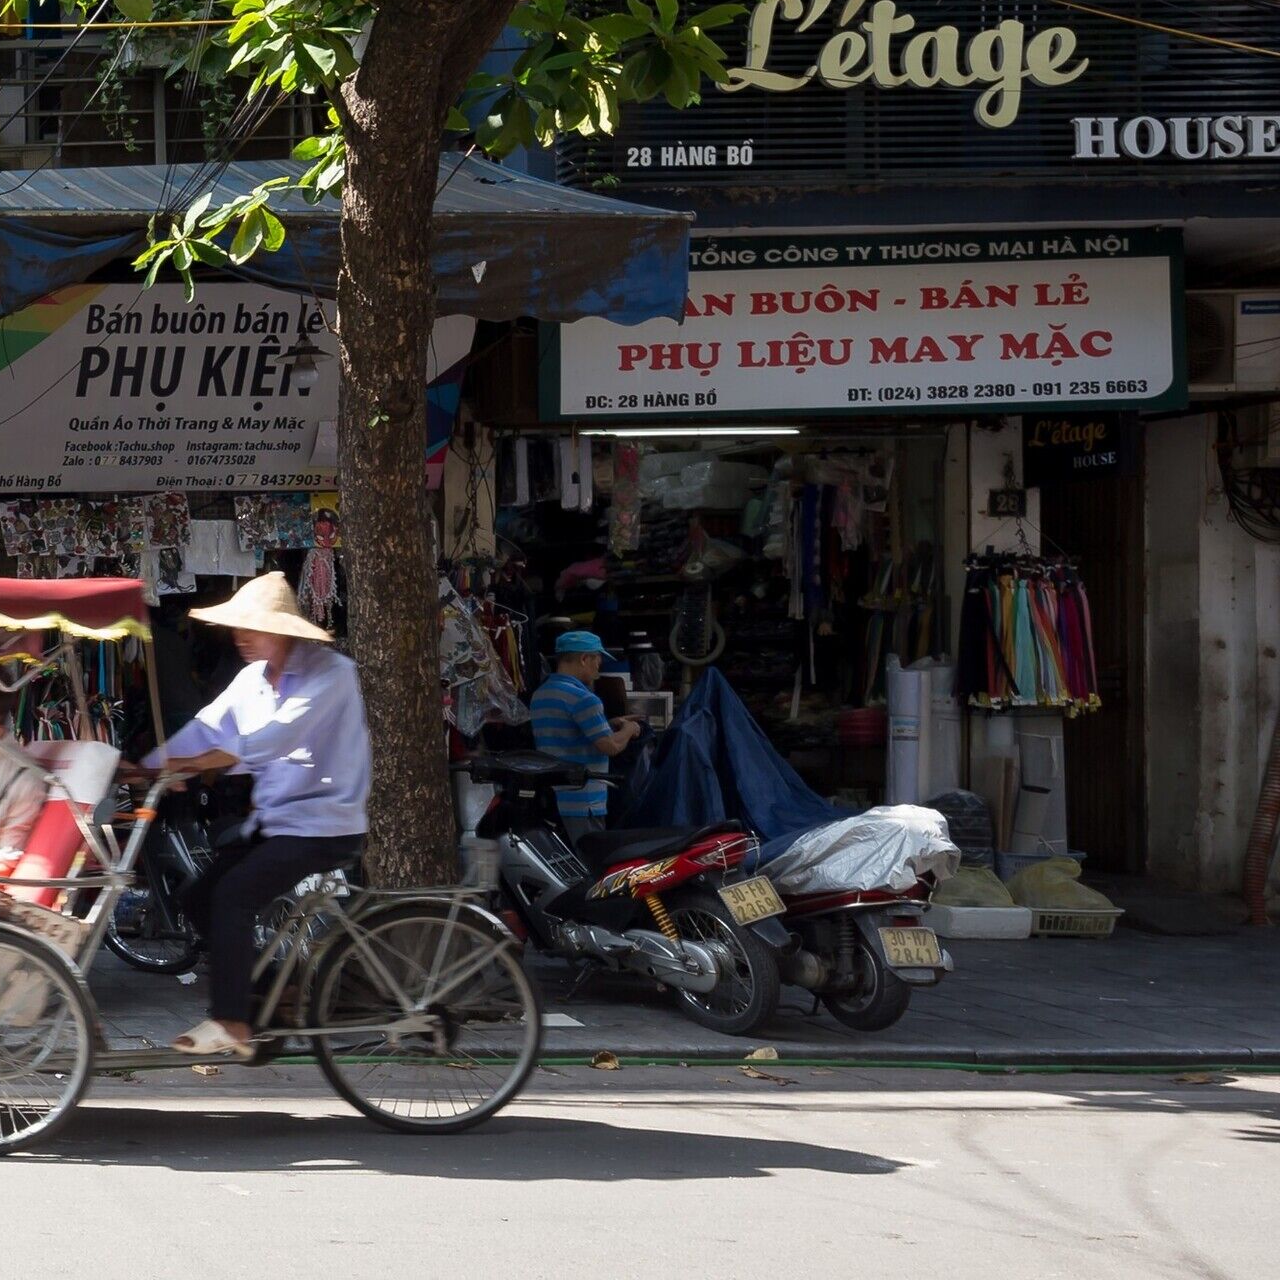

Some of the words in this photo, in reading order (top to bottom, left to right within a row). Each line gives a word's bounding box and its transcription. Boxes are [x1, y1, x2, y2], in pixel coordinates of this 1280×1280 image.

[627, 147, 652, 168] 28
[660, 140, 717, 168] HÀNG
[726, 137, 755, 167] BỒ
[690, 241, 757, 266] TỔNG
[764, 245, 839, 265] CÔNG
[846, 245, 871, 261] TY
[878, 241, 981, 261] THƯƠNG
[990, 240, 1034, 260] MẠI
[1042, 235, 1077, 255] HÀ
[1085, 233, 1129, 256] NỘI
[750, 283, 881, 315] BUÔN
[919, 279, 1020, 310] BÁN
[1033, 273, 1090, 307] LẺ
[86, 303, 141, 335] Bán
[150, 303, 228, 335] buôn
[236, 303, 292, 335] bán
[617, 342, 722, 377] PHỤ
[737, 331, 854, 375] LIỆU
[868, 334, 985, 364] MAY
[999, 322, 1114, 367] MẶC
[75, 345, 185, 413] PHỤ
[585, 395, 613, 409] ĐC:
[617, 394, 639, 408] 28
[643, 391, 690, 408] HÀNG
[847, 387, 872, 402] ĐT:
[877, 386, 922, 402] (024)
[927, 385, 969, 399] 3828
[974, 384, 1016, 398] 2380
[1032, 382, 1062, 396] 091
[1069, 381, 1101, 396] 235
[1105, 379, 1149, 394] 6663
[68, 416, 110, 432] Quần
[113, 414, 134, 431] Áo
[137, 415, 173, 431] Thời
[175, 416, 218, 433] Trang
[220, 417, 235, 431] &
[237, 417, 271, 433] May
[272, 416, 306, 434] Mặc
[64, 441, 112, 453] Facebook
[244, 440, 302, 454] tachu.shop
[62, 455, 85, 467] Zalo
[186, 454, 257, 466] 01674735028
[1073, 451, 1118, 469] HOUSE
[15, 475, 45, 490] Hàng
[156, 475, 183, 488] Điện
[185, 476, 218, 489] Thoại
[736, 896, 778, 920] 2369
[893, 947, 934, 965] 2841
